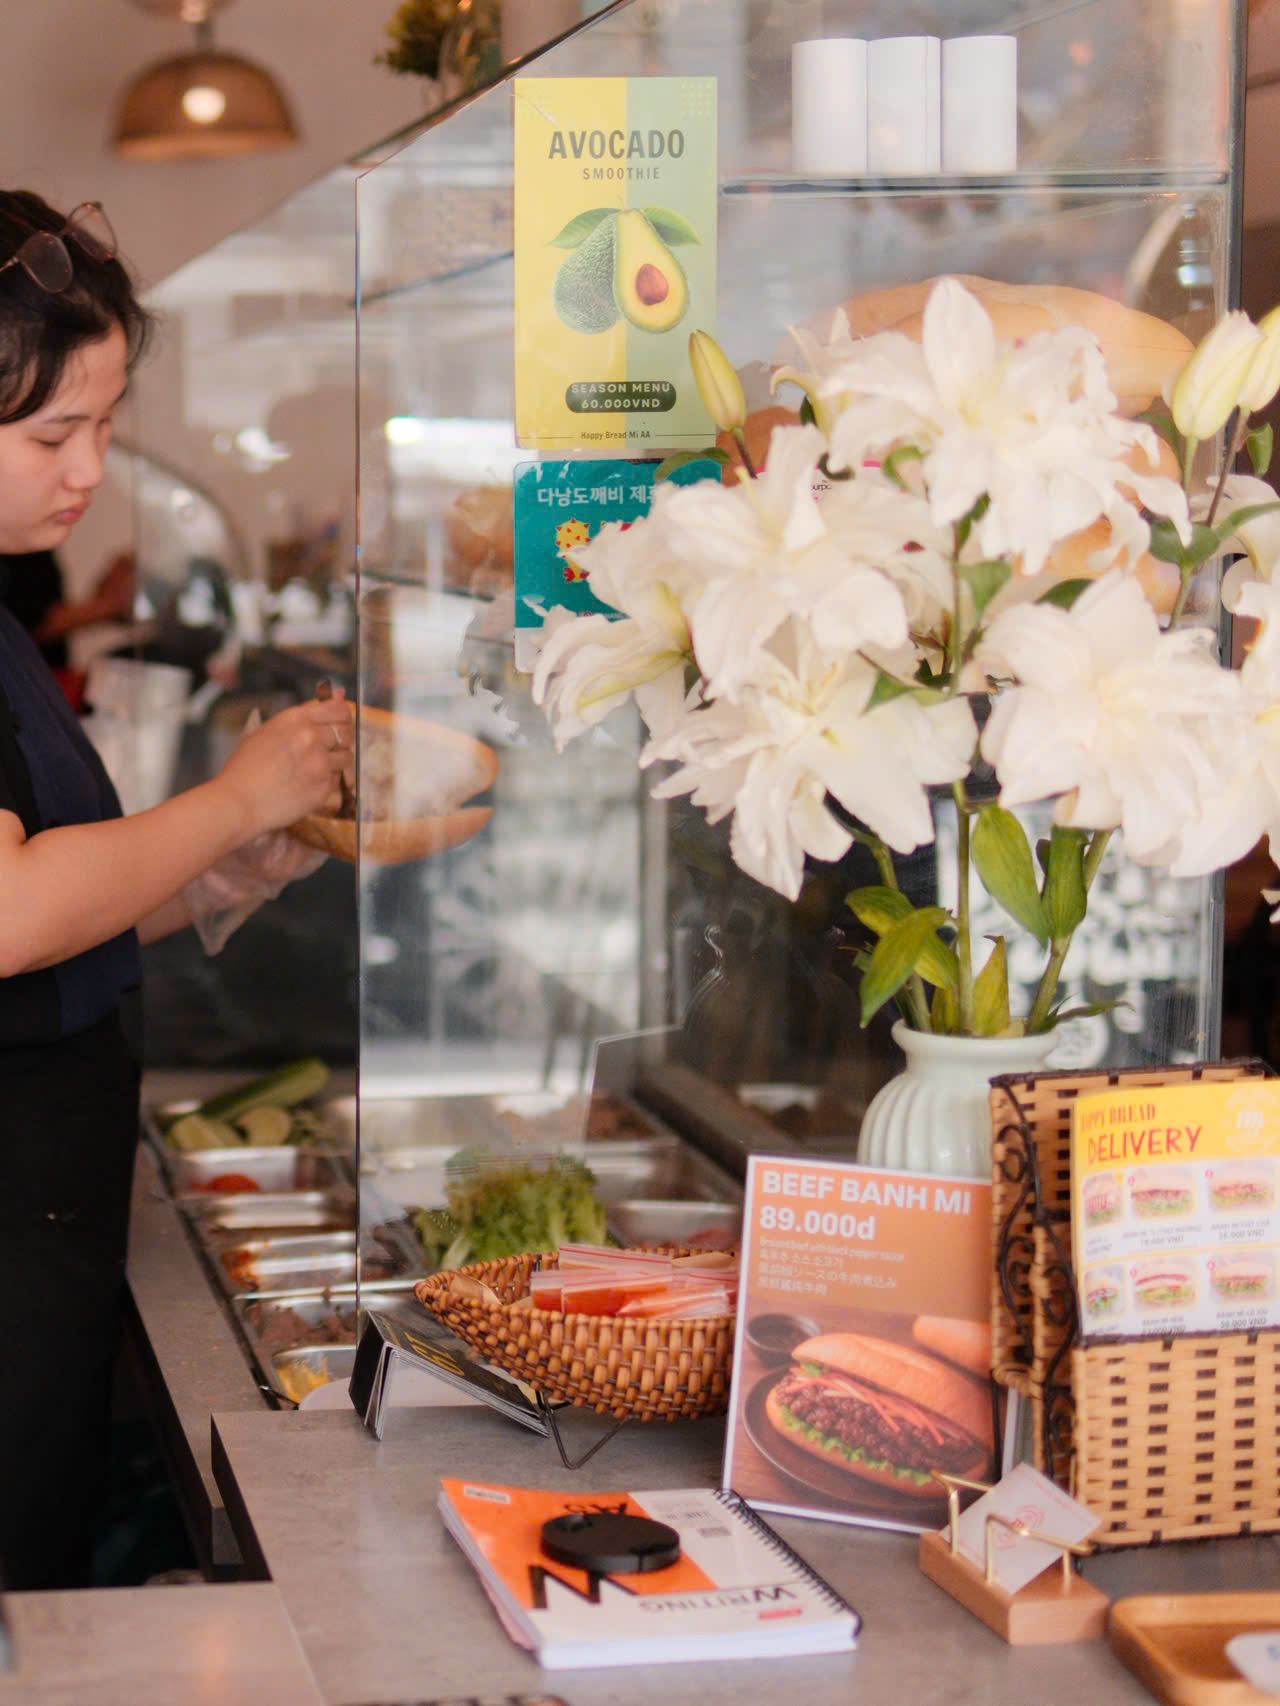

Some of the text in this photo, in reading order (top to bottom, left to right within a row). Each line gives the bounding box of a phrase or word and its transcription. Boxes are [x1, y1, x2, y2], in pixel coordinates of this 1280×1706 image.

[548, 129, 686, 160] AVOCADO
[583, 167, 661, 180] SMOOTHIE
[571, 383, 671, 394] SEASON MENU
[581, 398, 660, 409] 60.000VND
[581, 431, 603, 440] Happy
[606, 431, 627, 439] Bread
[641, 430, 651, 438] AA
[537, 485, 624, 507] 다낭도깨비
[1087, 1124, 1203, 1167] DELIVERY
[762, 1169, 972, 1215] BEEF BANH MI
[759, 1204, 876, 1241] 89.000d
[639, 1587, 799, 1614] WRITING
